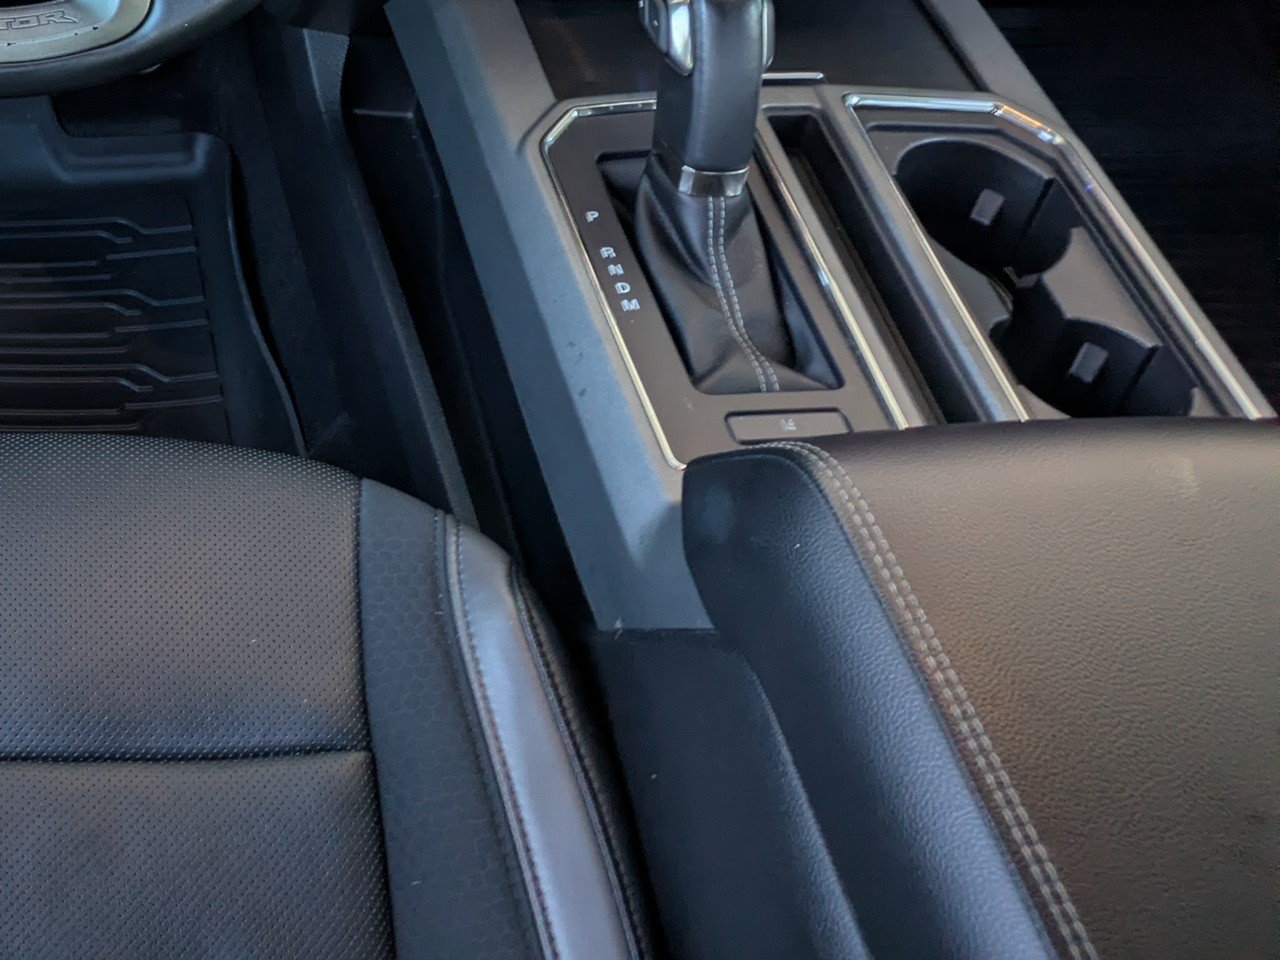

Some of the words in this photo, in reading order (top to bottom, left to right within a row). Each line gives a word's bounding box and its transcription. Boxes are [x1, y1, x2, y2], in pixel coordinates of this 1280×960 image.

[585, 210, 599, 223] P
[599, 246, 616, 259] R
[607, 264, 624, 276] N
[614, 282, 631, 295] D
[620, 298, 640, 312] M
